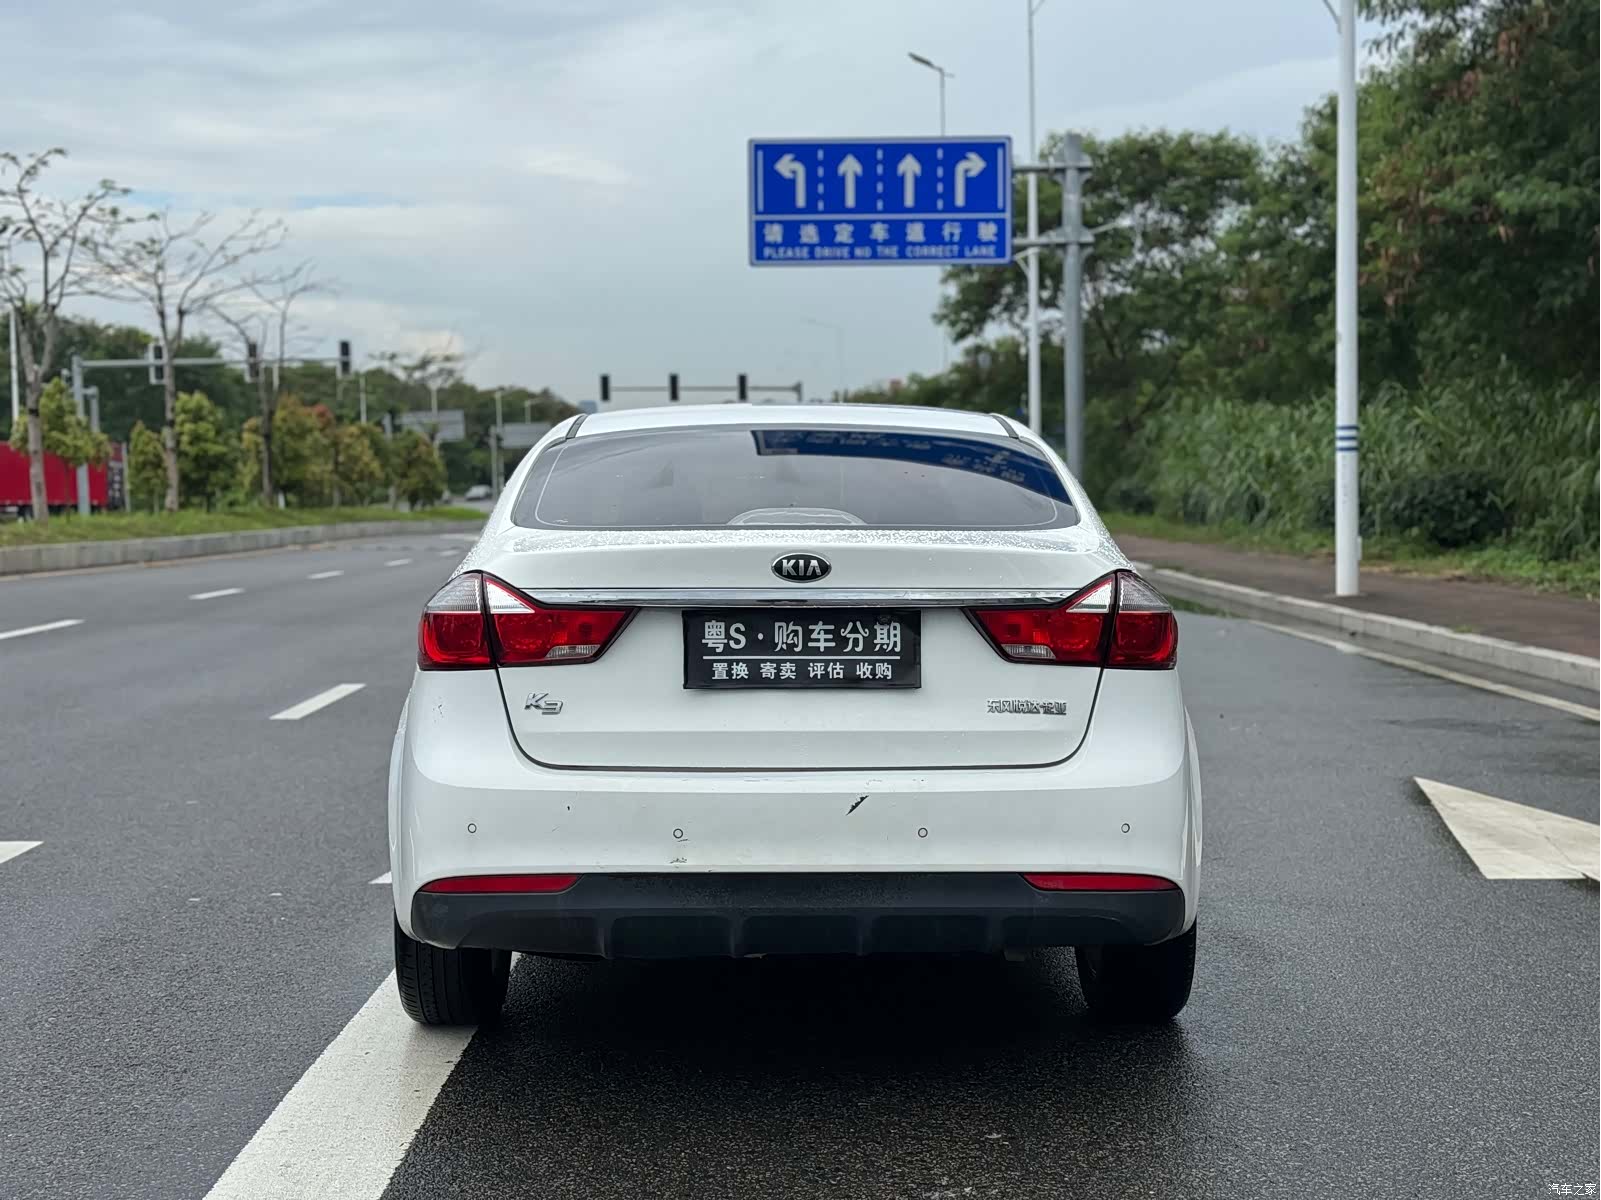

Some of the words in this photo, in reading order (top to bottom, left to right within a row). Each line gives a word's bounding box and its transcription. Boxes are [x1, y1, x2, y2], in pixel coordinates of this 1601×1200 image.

[763, 246, 810, 259] PLEASE
[814, 246, 850, 258] DRIVE
[876, 245, 899, 258] THE
[905, 245, 959, 257] CORRECT
[964, 245, 996, 257] LANE
[782, 559, 822, 576] KIA
[712, 662, 749, 680] 置换
[760, 662, 797, 680] 寄卖
[808, 662, 844, 680] 评估
[856, 662, 892, 680] 收购
